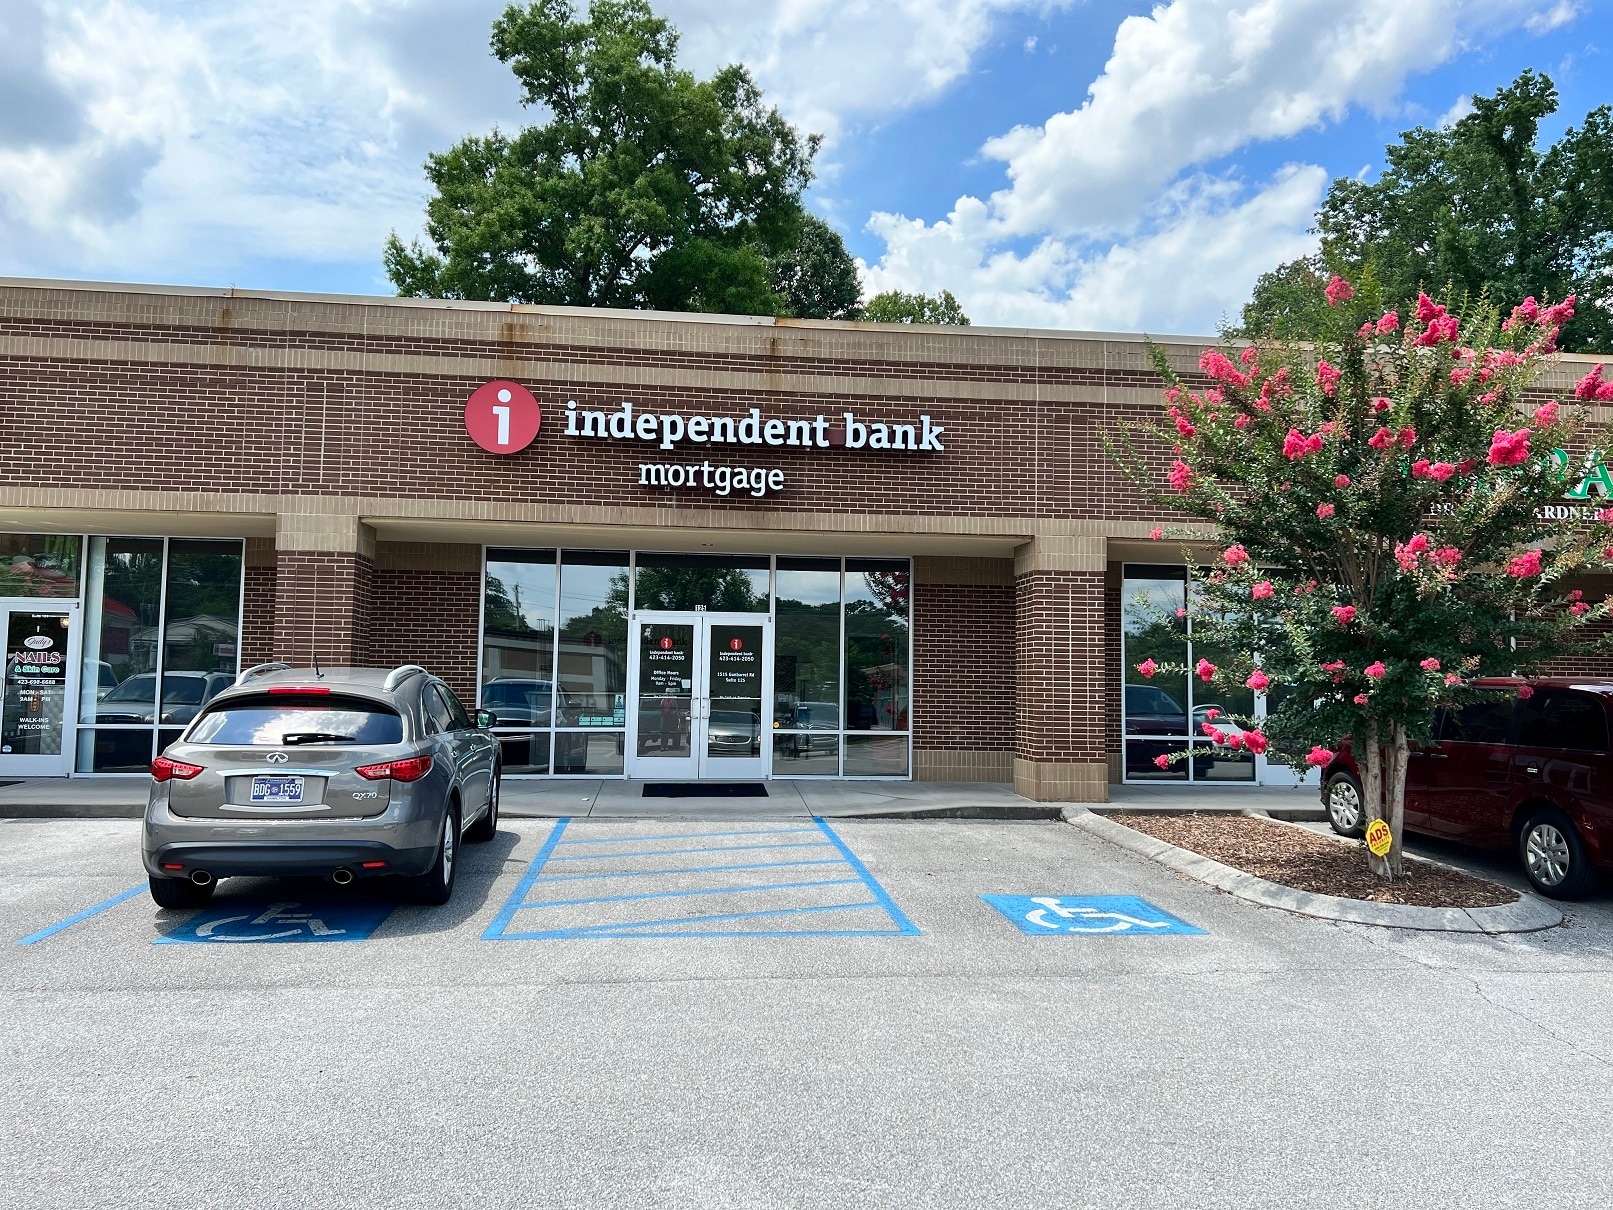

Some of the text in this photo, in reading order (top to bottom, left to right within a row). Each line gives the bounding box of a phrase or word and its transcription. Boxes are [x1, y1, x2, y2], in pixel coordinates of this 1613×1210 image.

[492, 388, 512, 445] i
[563, 400, 945, 450] independent bank
[638, 460, 785, 497] mortgage
[14, 651, 61, 664] NAILS
[15, 665, 60, 674] & Skin Care
[253, 783, 301, 796] BDG 1559
[352, 792, 378, 800] QX70
[1370, 825, 1388, 844] ADS
